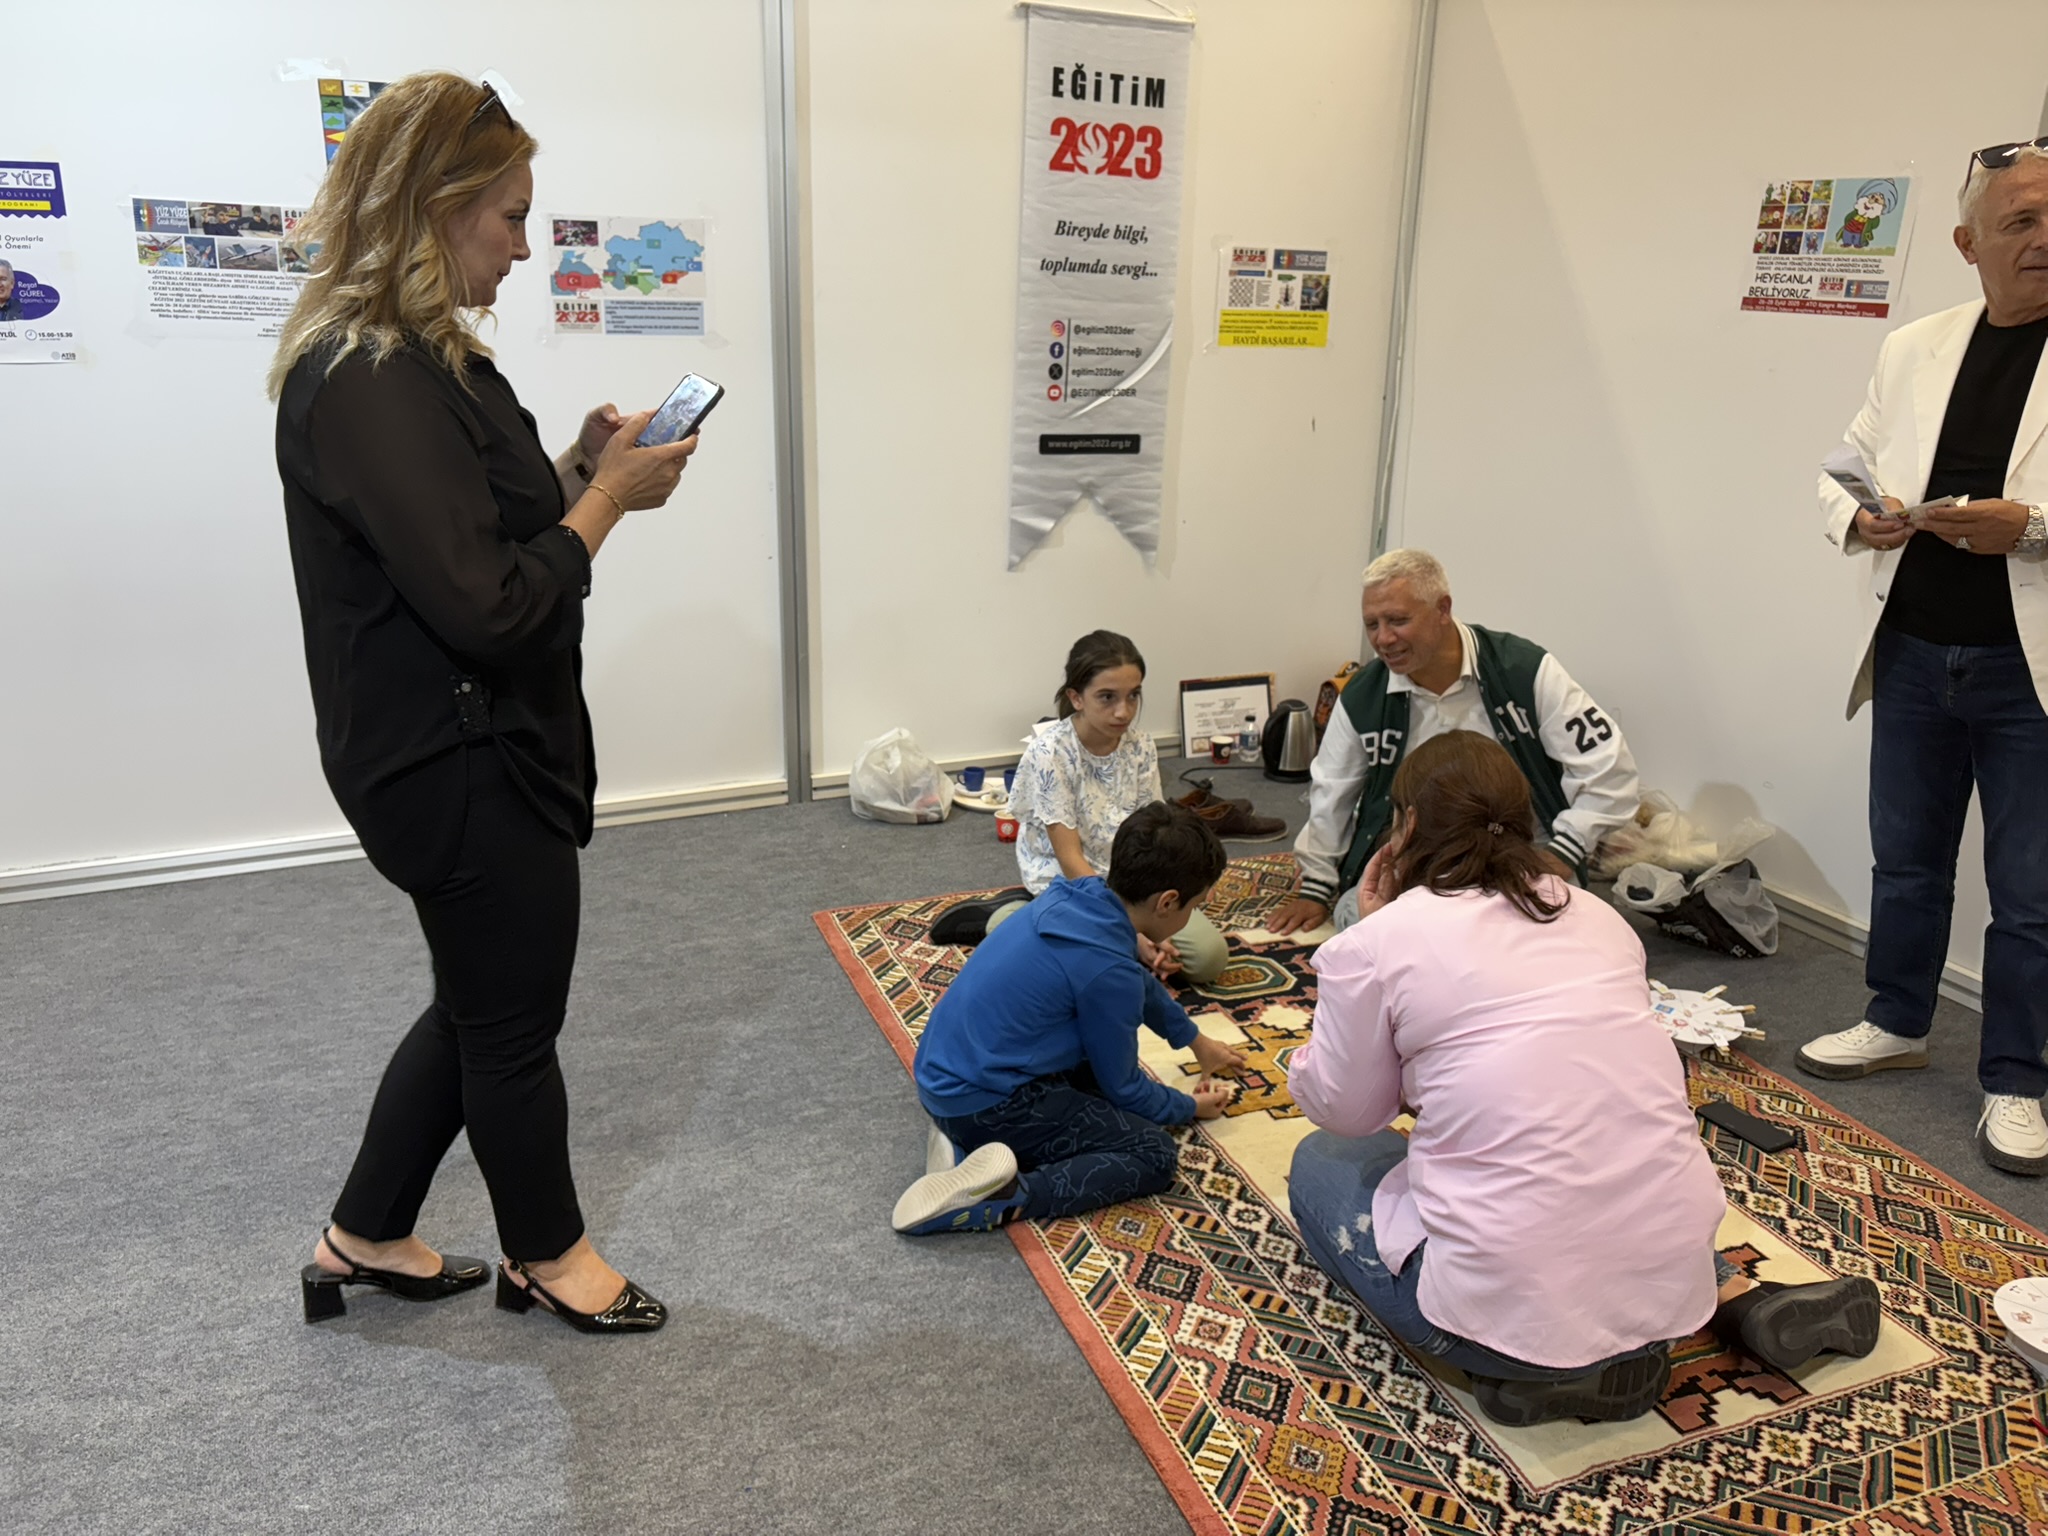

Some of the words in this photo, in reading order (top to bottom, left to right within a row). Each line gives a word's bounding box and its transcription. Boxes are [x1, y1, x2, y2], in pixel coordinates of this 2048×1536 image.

[1052, 63, 1165, 108] EĞİTİM
[1049, 117, 1162, 180] 2023
[11, 170, 52, 186] YÜZE
[1054, 220, 1109, 242] Bireyde
[1113, 225, 1148, 245] bilgi,
[1040, 257, 1107, 276] toplumda
[1111, 262, 1158, 280] sevgi...
[1755, 273, 1812, 284] HEYECANLA
[1748, 285, 1812, 299] BEKLİYORUZ.
[1565, 706, 1612, 754] 25
